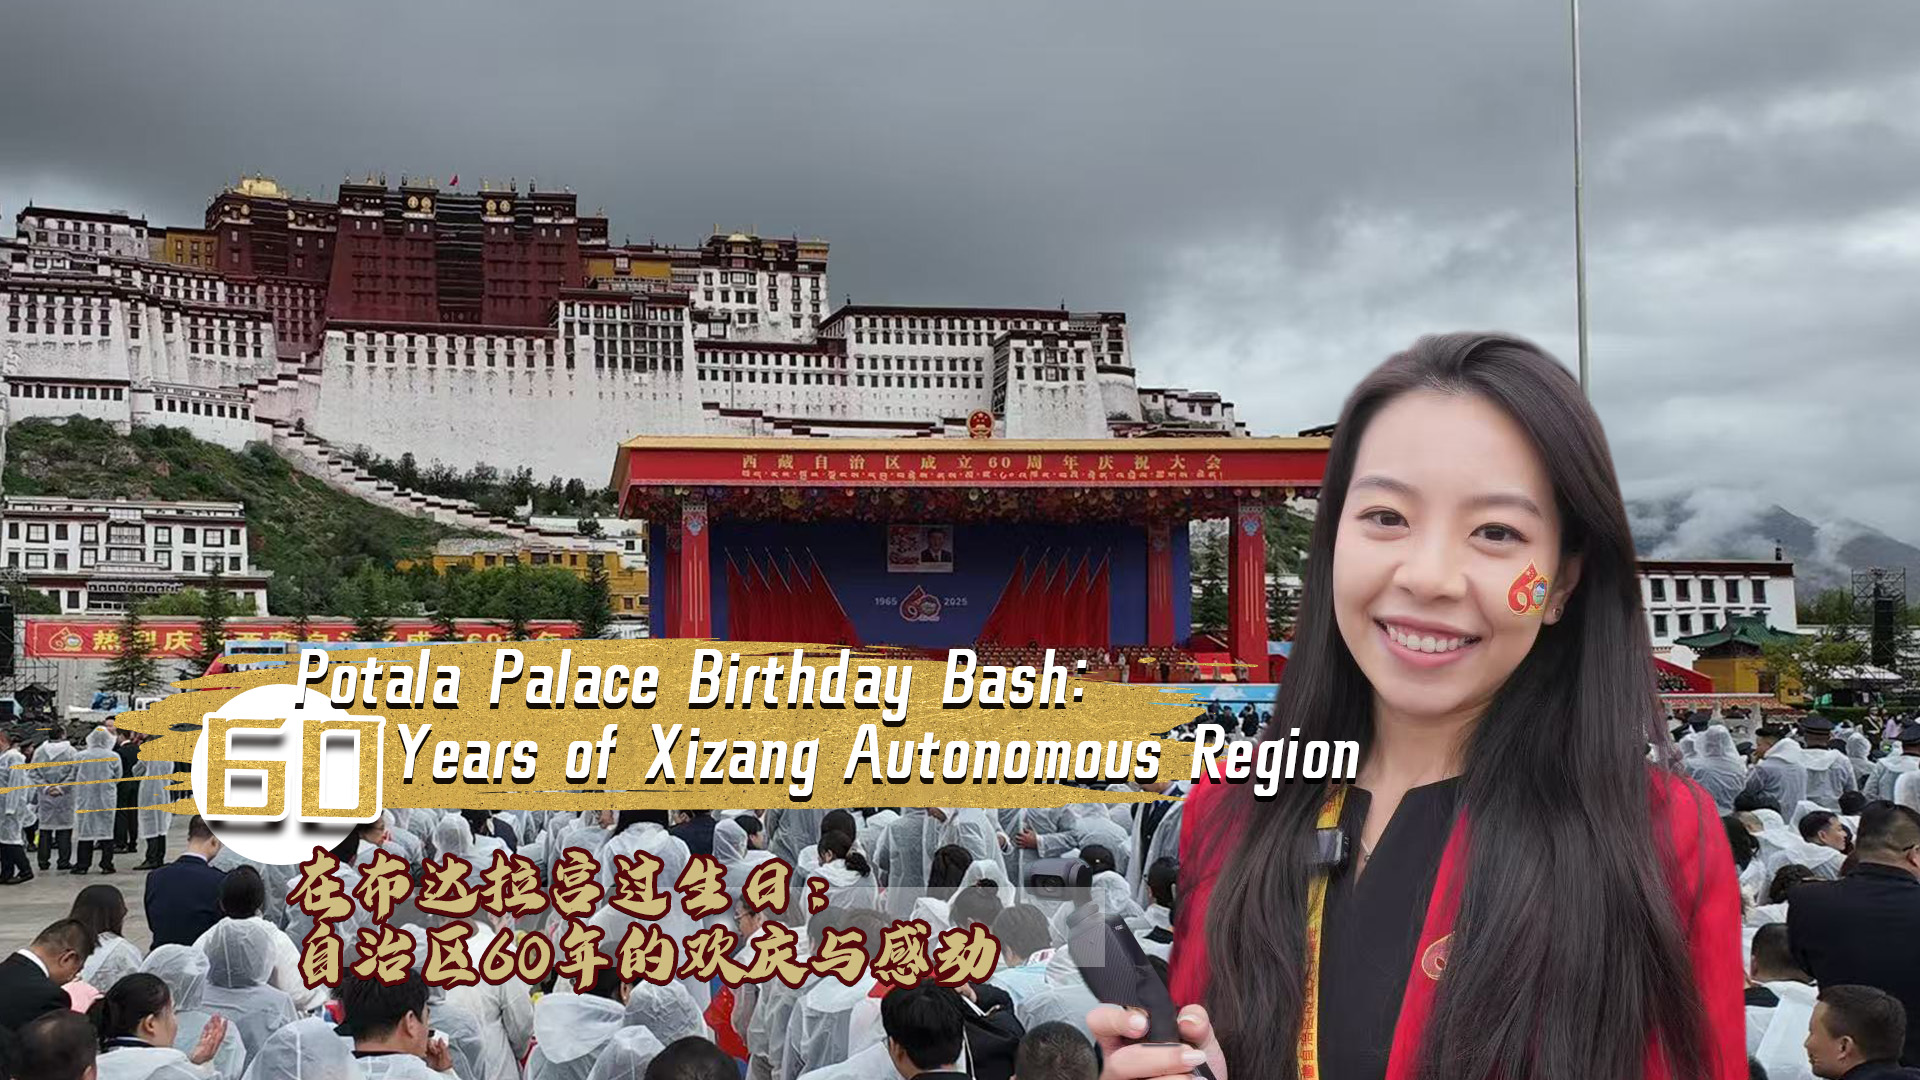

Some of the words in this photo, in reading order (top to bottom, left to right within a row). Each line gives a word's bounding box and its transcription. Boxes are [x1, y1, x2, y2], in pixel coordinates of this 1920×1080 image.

[742, 454, 1222, 470] 西藏自治区成立60周年庆祝大会
[875, 597, 898, 606] 1965
[944, 597, 968, 606] 2025
